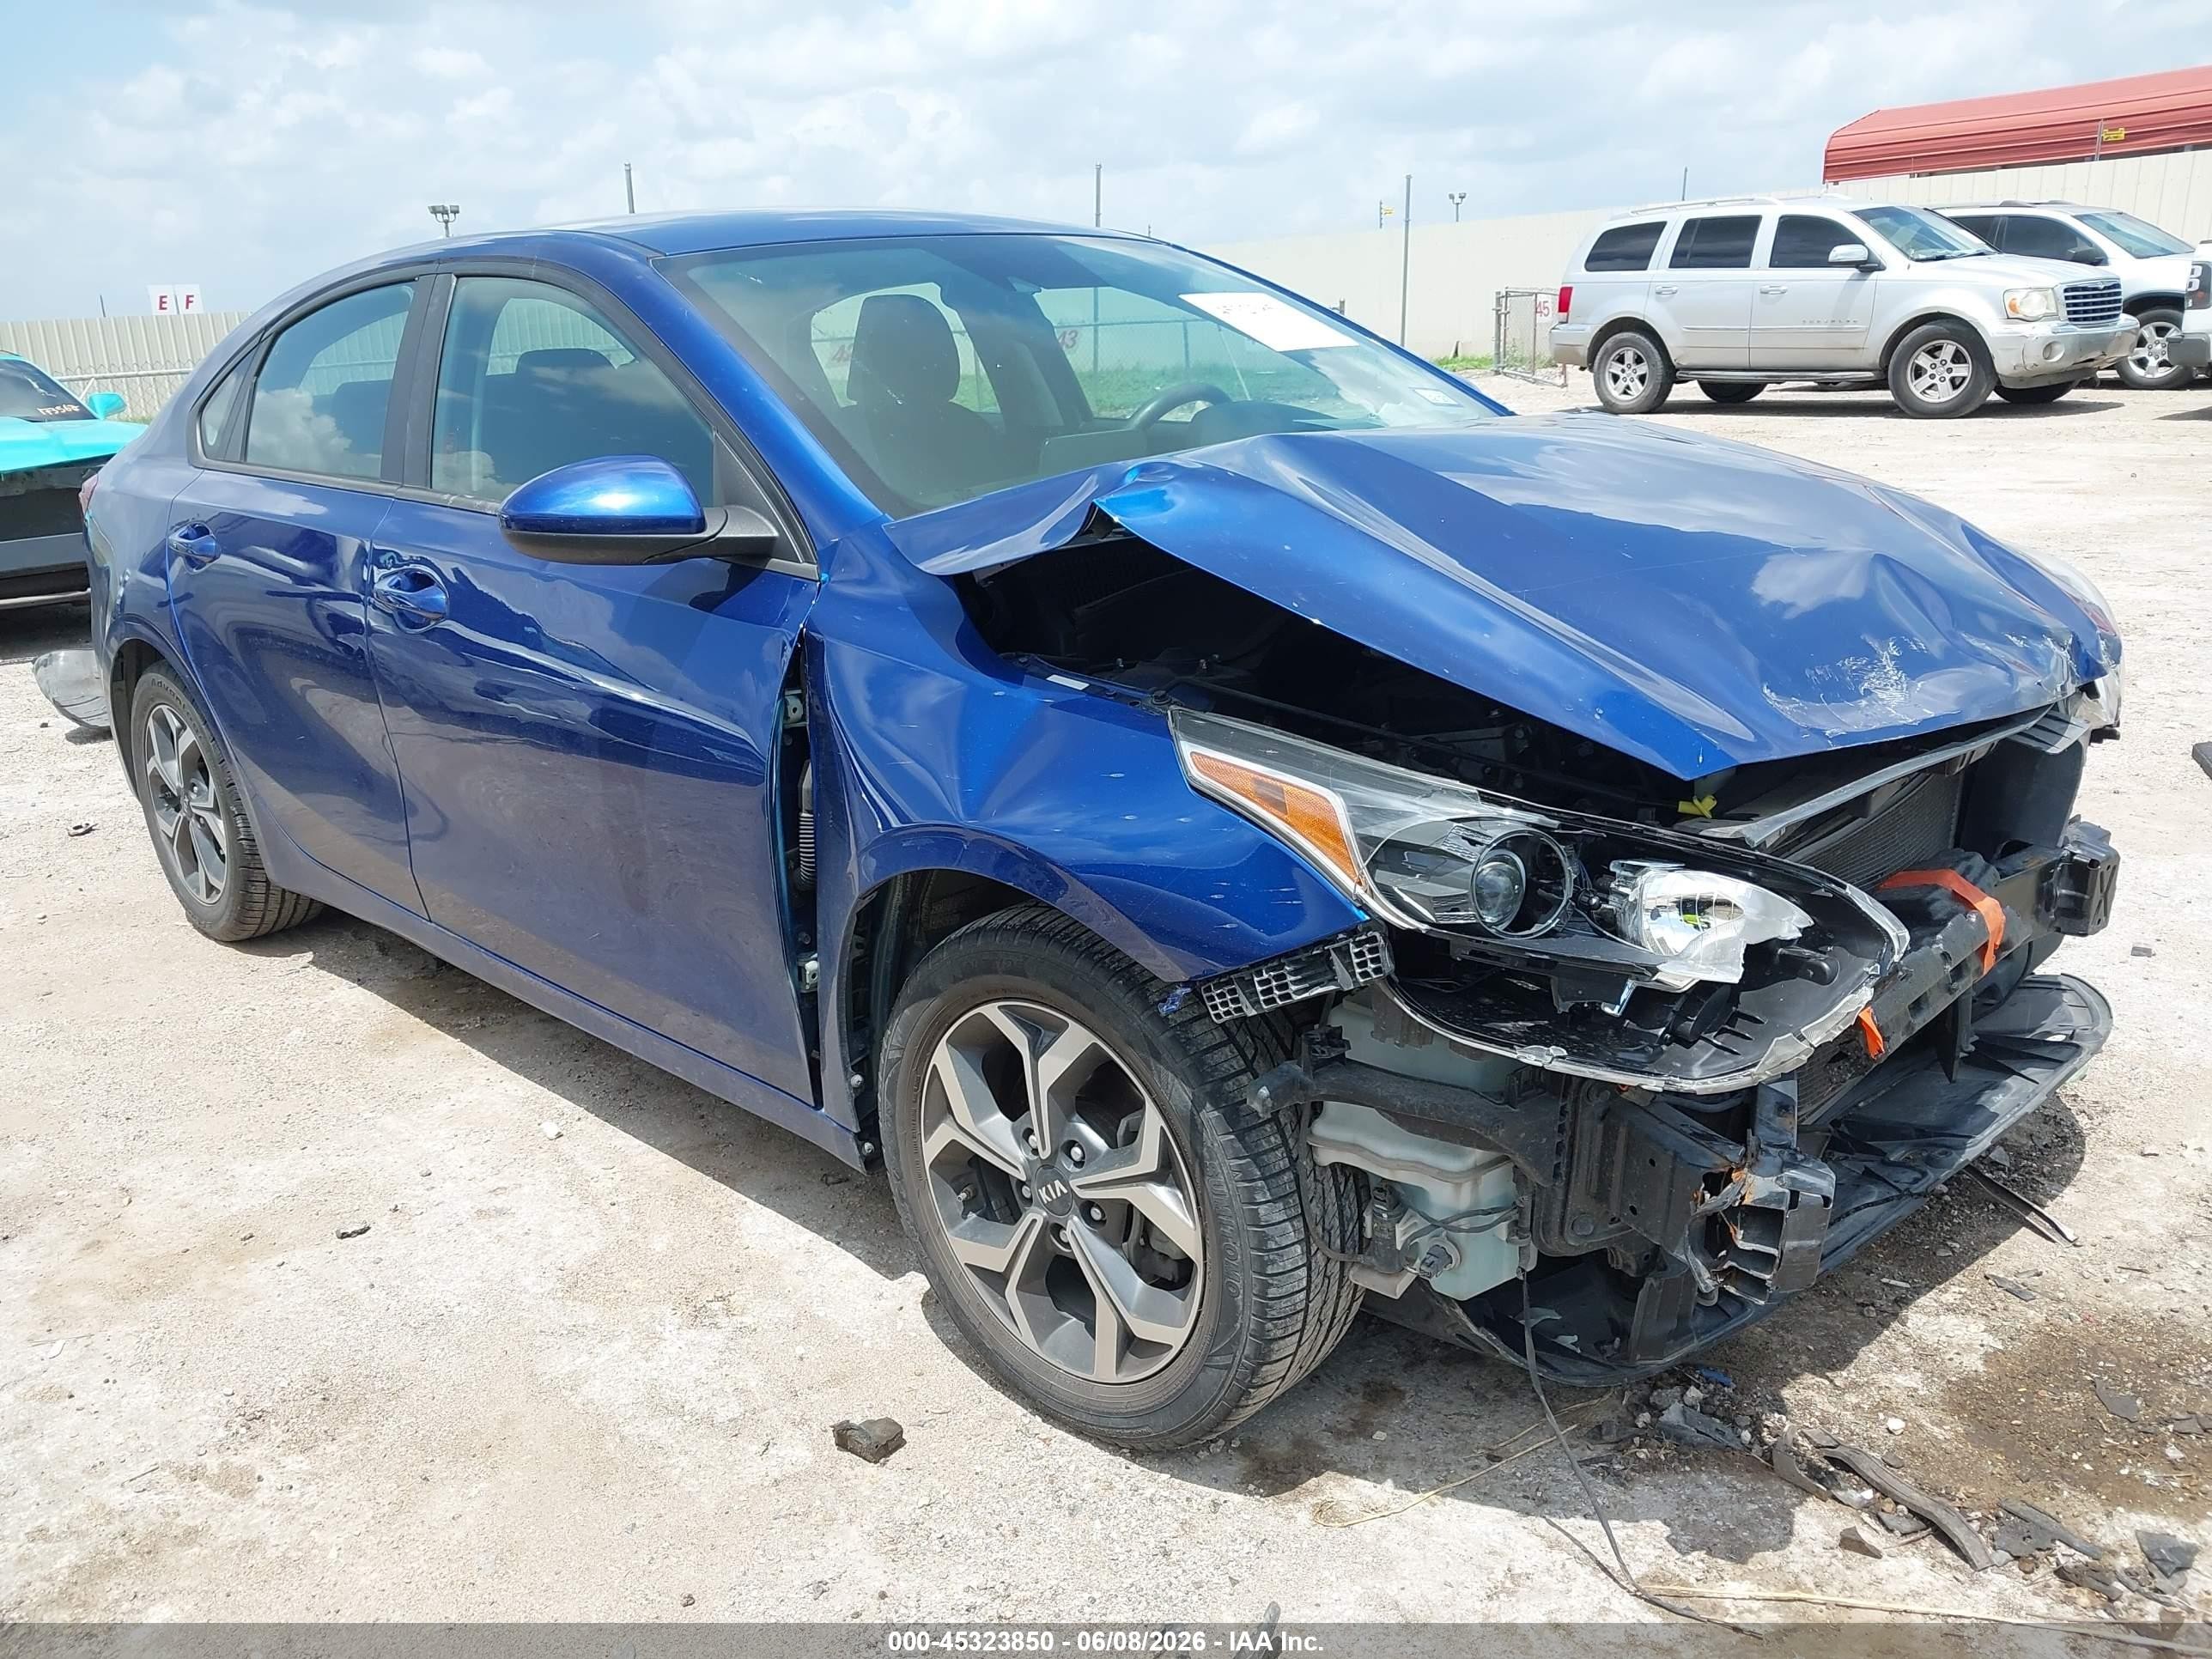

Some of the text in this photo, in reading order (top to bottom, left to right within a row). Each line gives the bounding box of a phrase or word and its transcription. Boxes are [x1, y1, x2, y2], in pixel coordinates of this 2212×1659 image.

[158, 295, 168, 311] E
[185, 294, 195, 310] F
[1534, 301, 1550, 317] 45
[1057, 329, 1079, 349] 43
[1037, 1179, 1068, 1204] KIA
